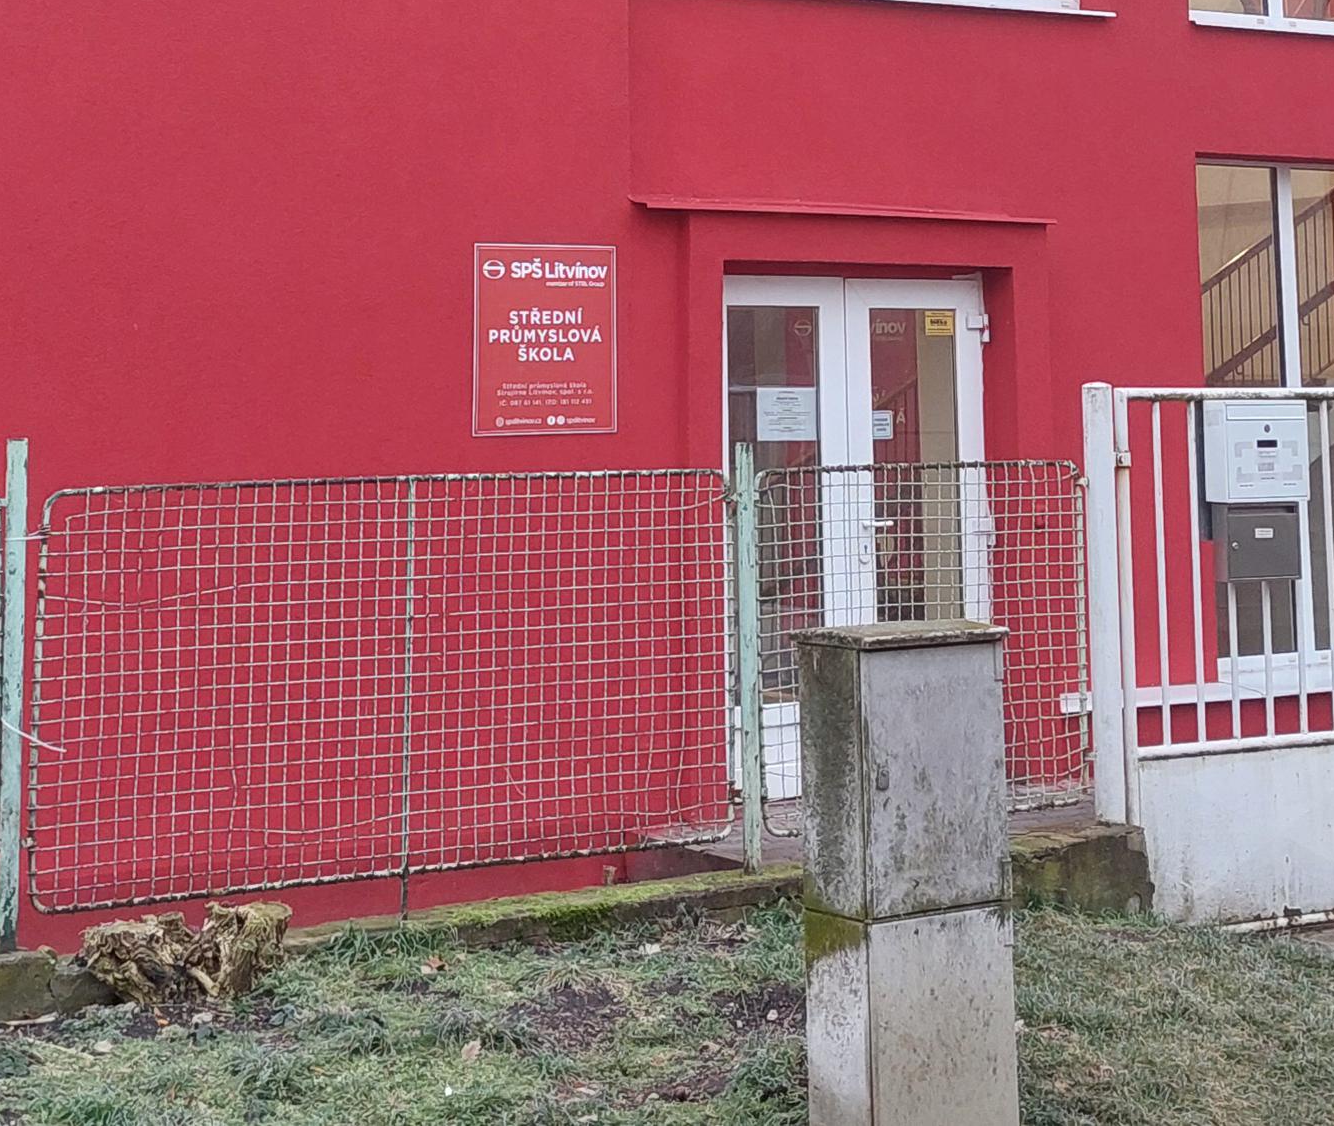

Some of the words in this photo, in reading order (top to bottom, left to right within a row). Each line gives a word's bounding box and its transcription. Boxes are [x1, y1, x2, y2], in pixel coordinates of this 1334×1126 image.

[511, 258, 542, 279] SPŠ
[545, 262, 608, 279] Litvínov
[509, 307, 583, 325] STŘEDNÍ
[488, 325, 602, 343] PRŮMYSLOVÁ
[518, 344, 575, 361] ŠKOLA
